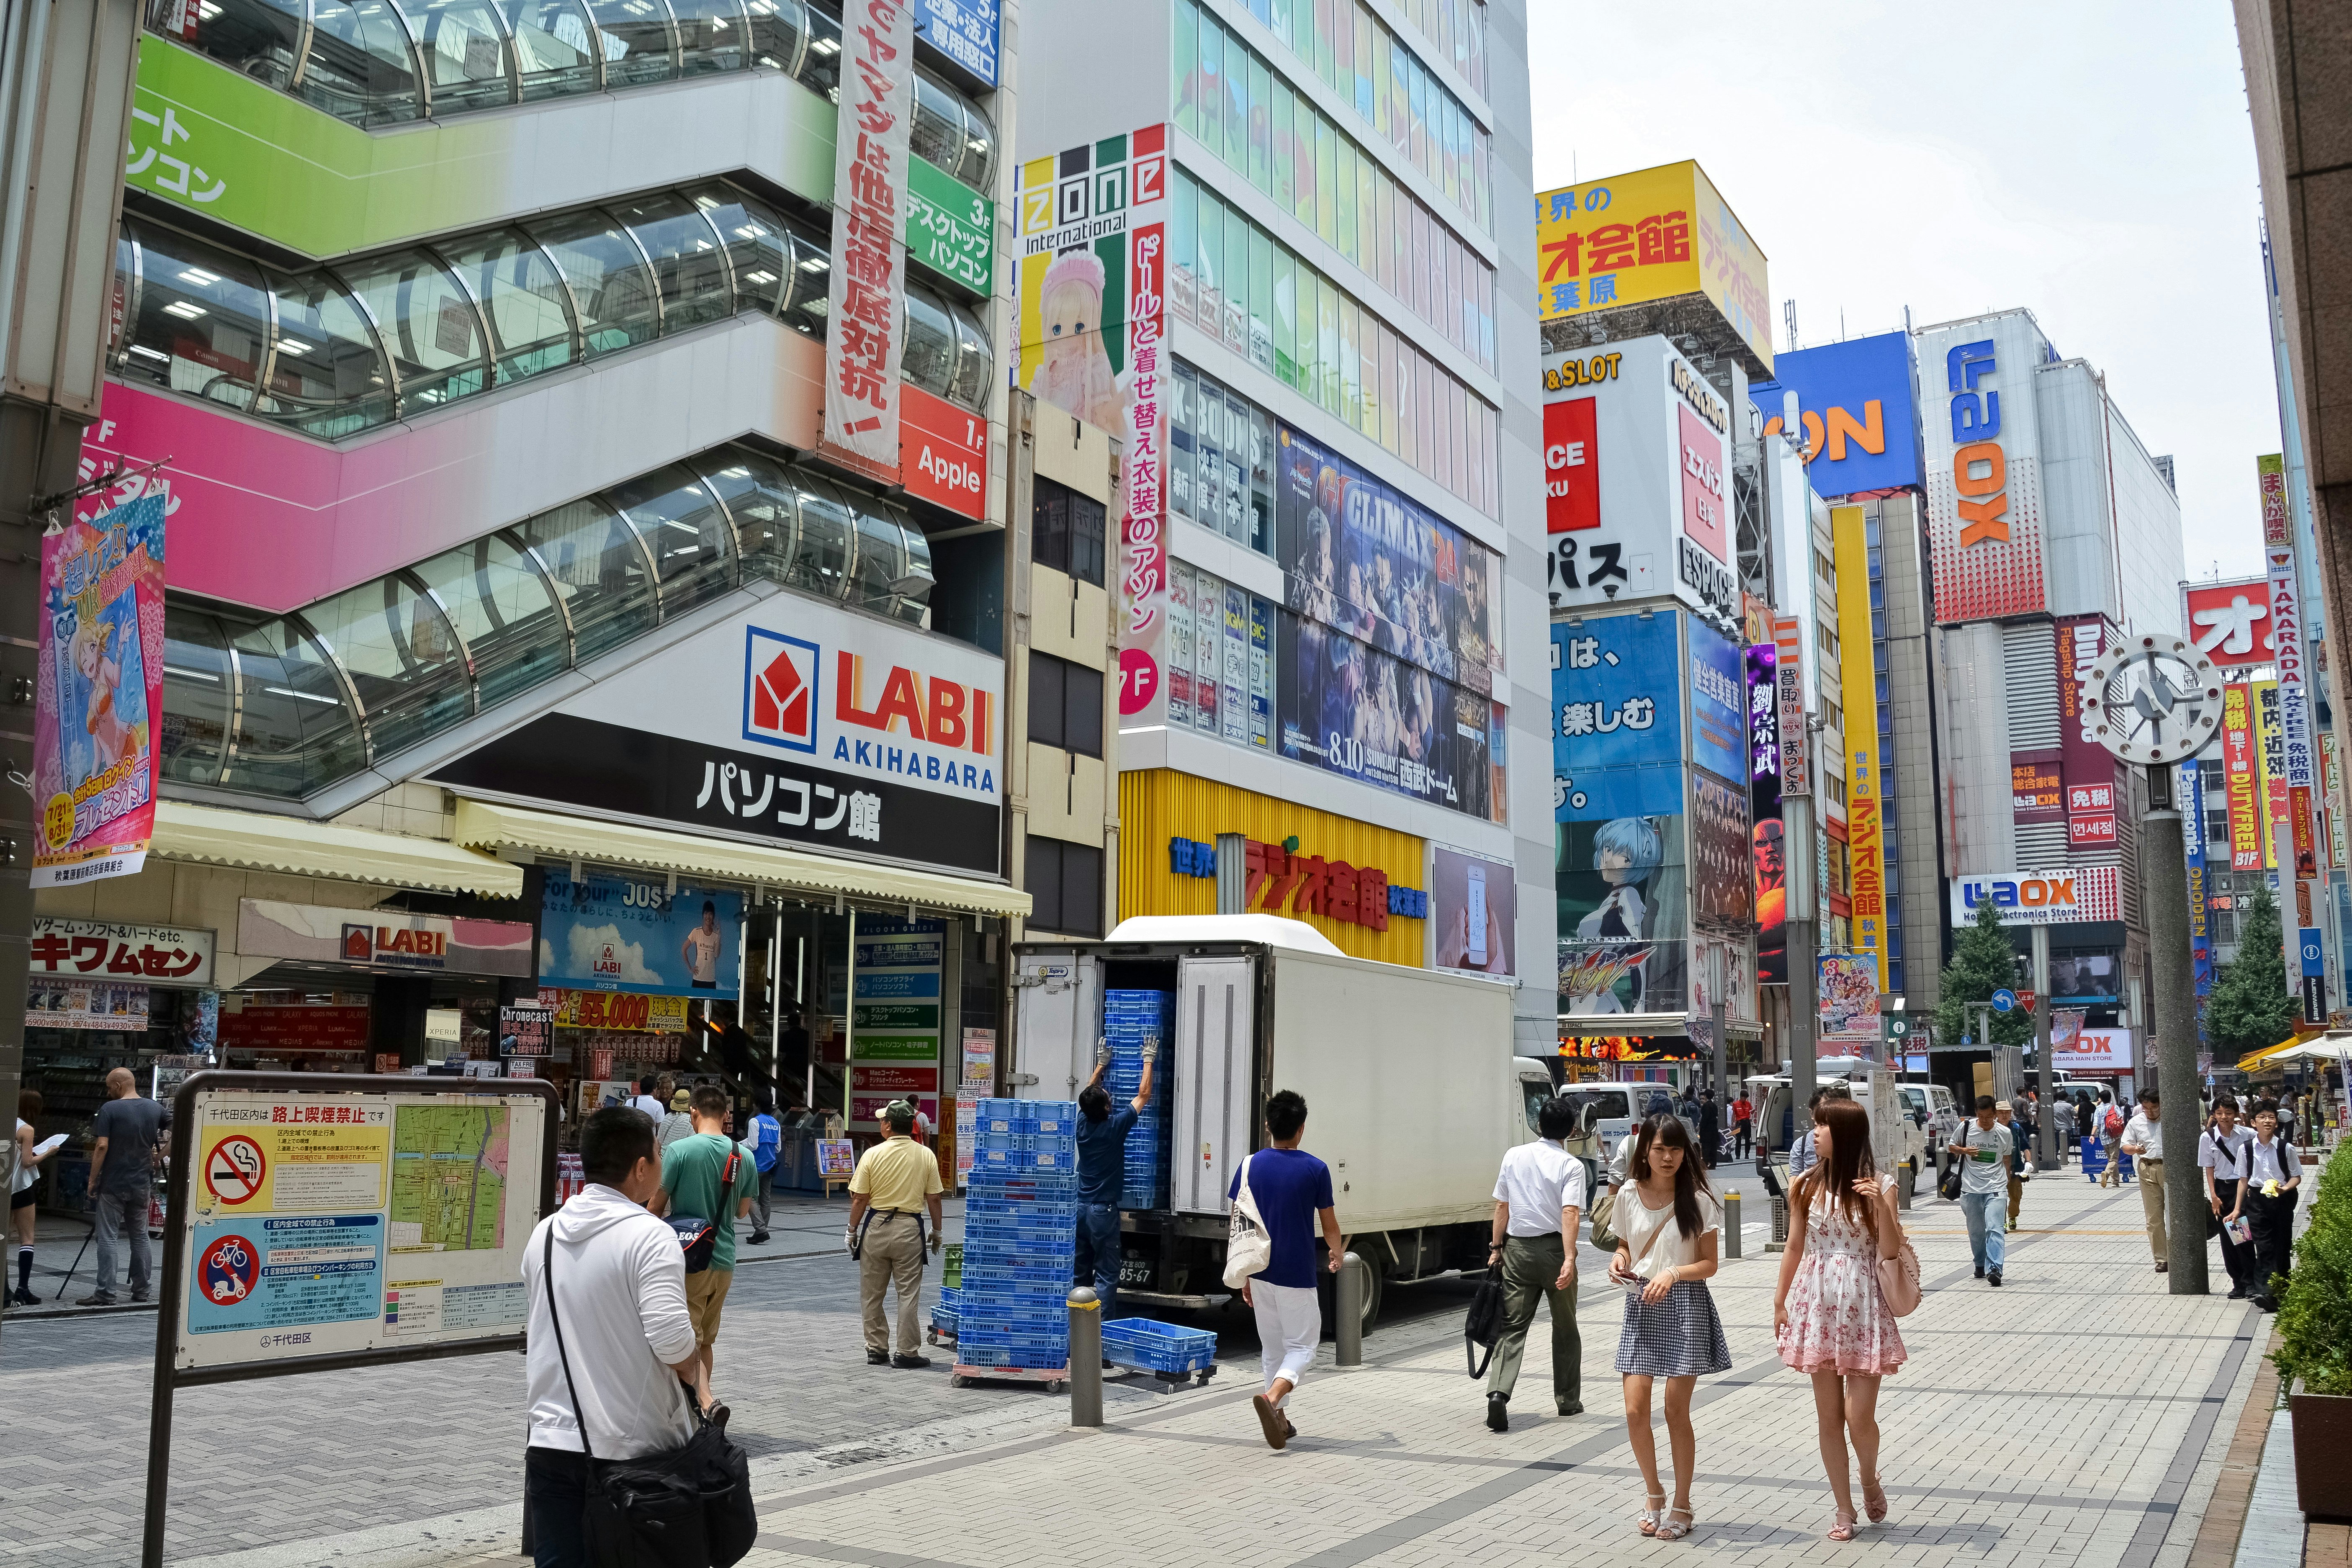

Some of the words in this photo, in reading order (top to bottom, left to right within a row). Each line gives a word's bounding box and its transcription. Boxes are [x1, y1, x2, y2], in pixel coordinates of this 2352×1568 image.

[932, 17, 995, 82] 専用窓口
[839, 0, 903, 436] でヤマダは他店徹底対抗！
[907, 198, 991, 261] デスクトップ
[972, 199, 991, 230] 3F
[1026, 212, 1126, 254] International
[929, 236, 989, 285] パソコン
[1541, 210, 1691, 284] オ会館
[966, 419, 984, 450] 1F
[1129, 234, 1163, 631] ドールと着せ替え衣装のアゾン
[1171, 378, 1261, 465] K-BOOKS
[918, 445, 980, 493] Apple
[1685, 444, 1723, 501] エスパス
[2261, 473, 2288, 543] まんが喫茶
[1346, 488, 1434, 570] CLIMAX
[1432, 529, 1461, 591] 24
[1677, 536, 1735, 609] ESPACE
[2060, 627, 2074, 679] Flagship
[2272, 578, 2302, 684] TAKARADA
[62, 645, 70, 681] AYASE
[1693, 655, 1740, 715] 健全営業宣言
[836, 650, 995, 757] LABI
[1779, 668, 1799, 717] 買取り
[2064, 682, 2076, 717] Store
[2225, 689, 2248, 730] 免税
[1562, 698, 1655, 737] 楽しむ
[1752, 682, 1776, 776] 劉宗武
[2260, 689, 2285, 776] 都内・近郊
[834, 735, 995, 793] AKIHABARA
[1329, 732, 1364, 773] 8.10
[1399, 758, 1458, 803] 西武ドーム
[1783, 740, 1799, 794] まっくす
[1855, 751, 1870, 796] 世界の
[2012, 766, 2035, 778] 本店
[2013, 776, 2059, 791] 総合家電
[48, 802, 66, 821] 7/21
[697, 761, 881, 842] パソコン館
[2072, 788, 2110, 808] 免税
[2181, 769, 2198, 856] Panasonic
[49, 823, 66, 841] 8/31
[2072, 821, 2113, 838] 면세점
[2296, 795, 2308, 848] カードキングダム
[1851, 797, 1881, 917] ラジオ会館
[2234, 851, 2259, 866] B1F
[1387, 884, 1427, 920] 秋葉原
[2051, 907, 2078, 917] Store
[2191, 866, 2206, 937] ONODEN
[31, 933, 202, 977] キワムセン
[376, 926, 447, 956] LABI
[593, 960, 622, 974] LABI
[1048, 967, 1065, 975] Topre
[502, 1007, 553, 1022] Chromecast
[652, 997, 682, 1017] 現金
[2311, 977, 2319, 1017] ALIENWARE
[209, 1106, 386, 1124] 千代田区内は路上喫煙禁止です
[277, 1129, 335, 1138] 区内全域での禁止行為
[273, 1219, 335, 1229] 区内全域での禁止行為
[1119, 1270, 1150, 1282] 85-67
[272, 1332, 311, 1346] 千代田区
